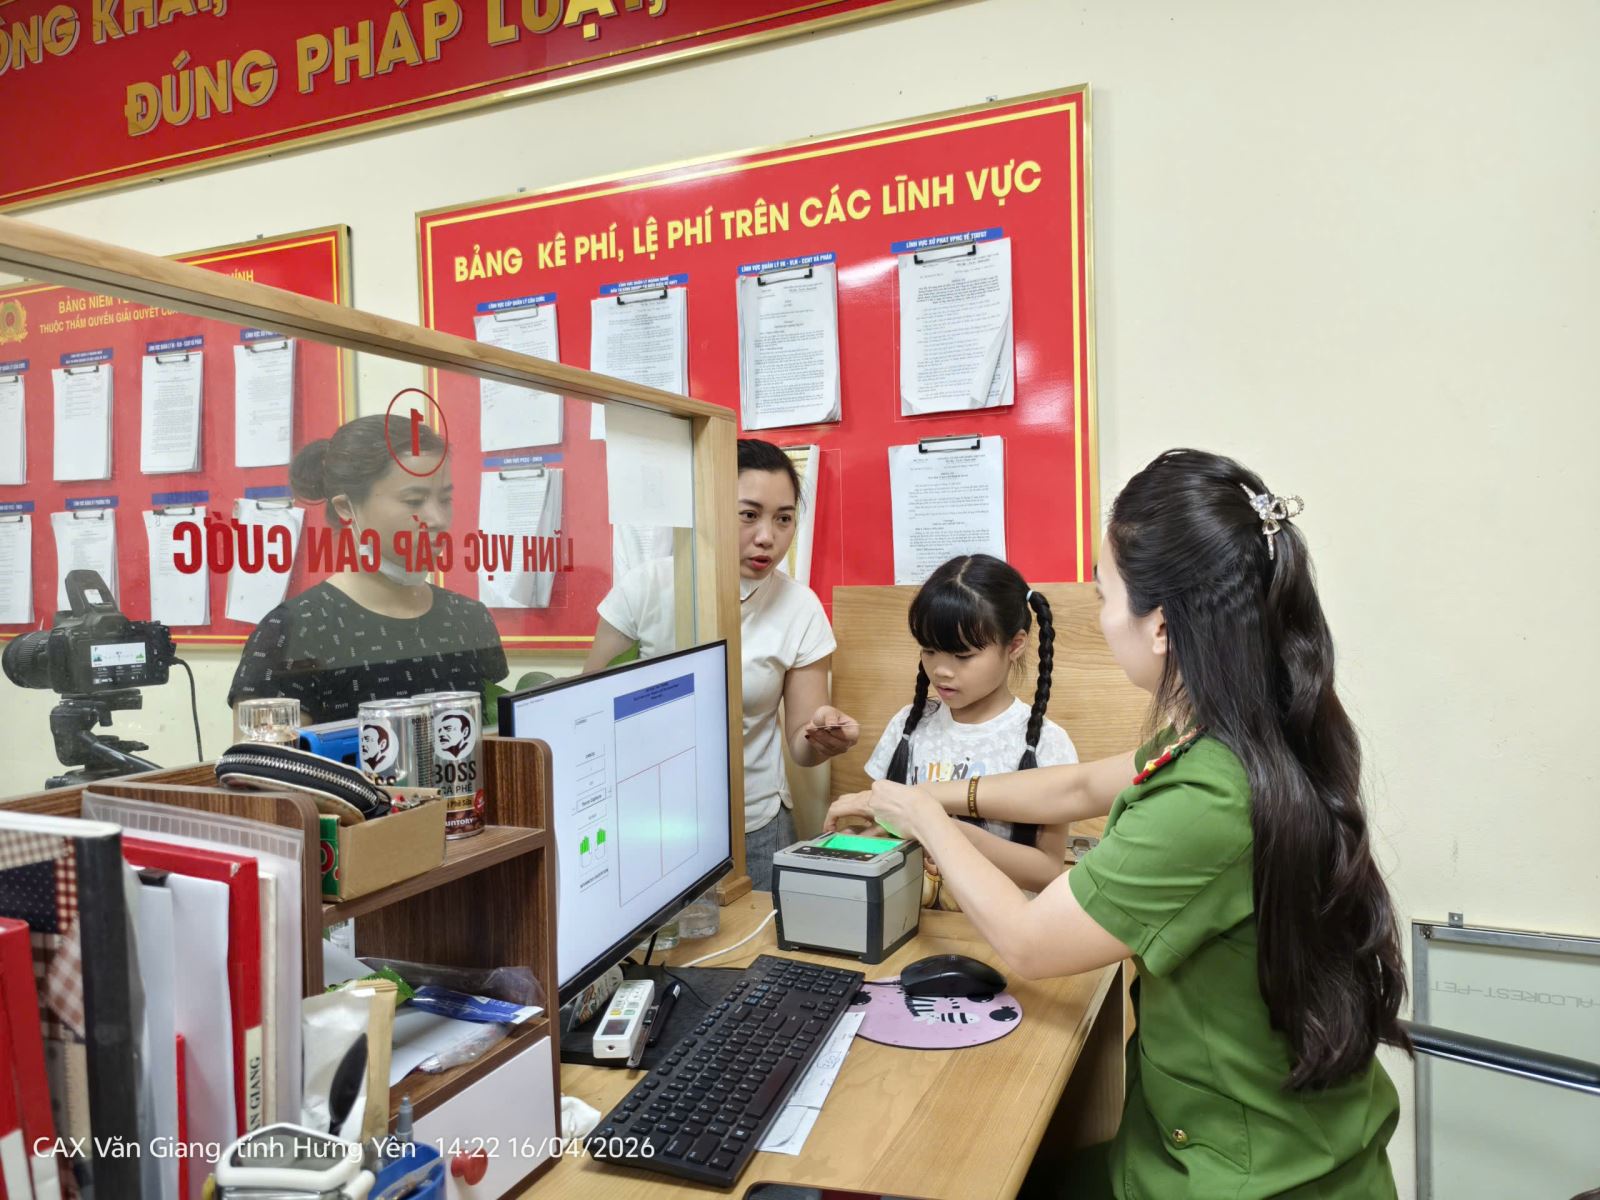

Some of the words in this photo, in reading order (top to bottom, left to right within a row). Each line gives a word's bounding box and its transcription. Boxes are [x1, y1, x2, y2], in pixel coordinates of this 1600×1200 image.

[124, 50, 278, 137] ĐÚNG
[296, 0, 463, 94] PHÁP
[454, 244, 523, 283] BẢNG
[538, 232, 567, 269] KÊ
[574, 222, 624, 263] PHÍ,
[633, 216, 659, 260] LỆ
[667, 206, 714, 249] PHÍ
[720, 198, 790, 240] TRÊN
[799, 184, 872, 229] CÁC
[882, 175, 955, 215] LĨNH
[965, 159, 1042, 207] VỰC
[58, 295, 87, 314] BẢNG
[249, 1056, 261, 1110] GIANG
